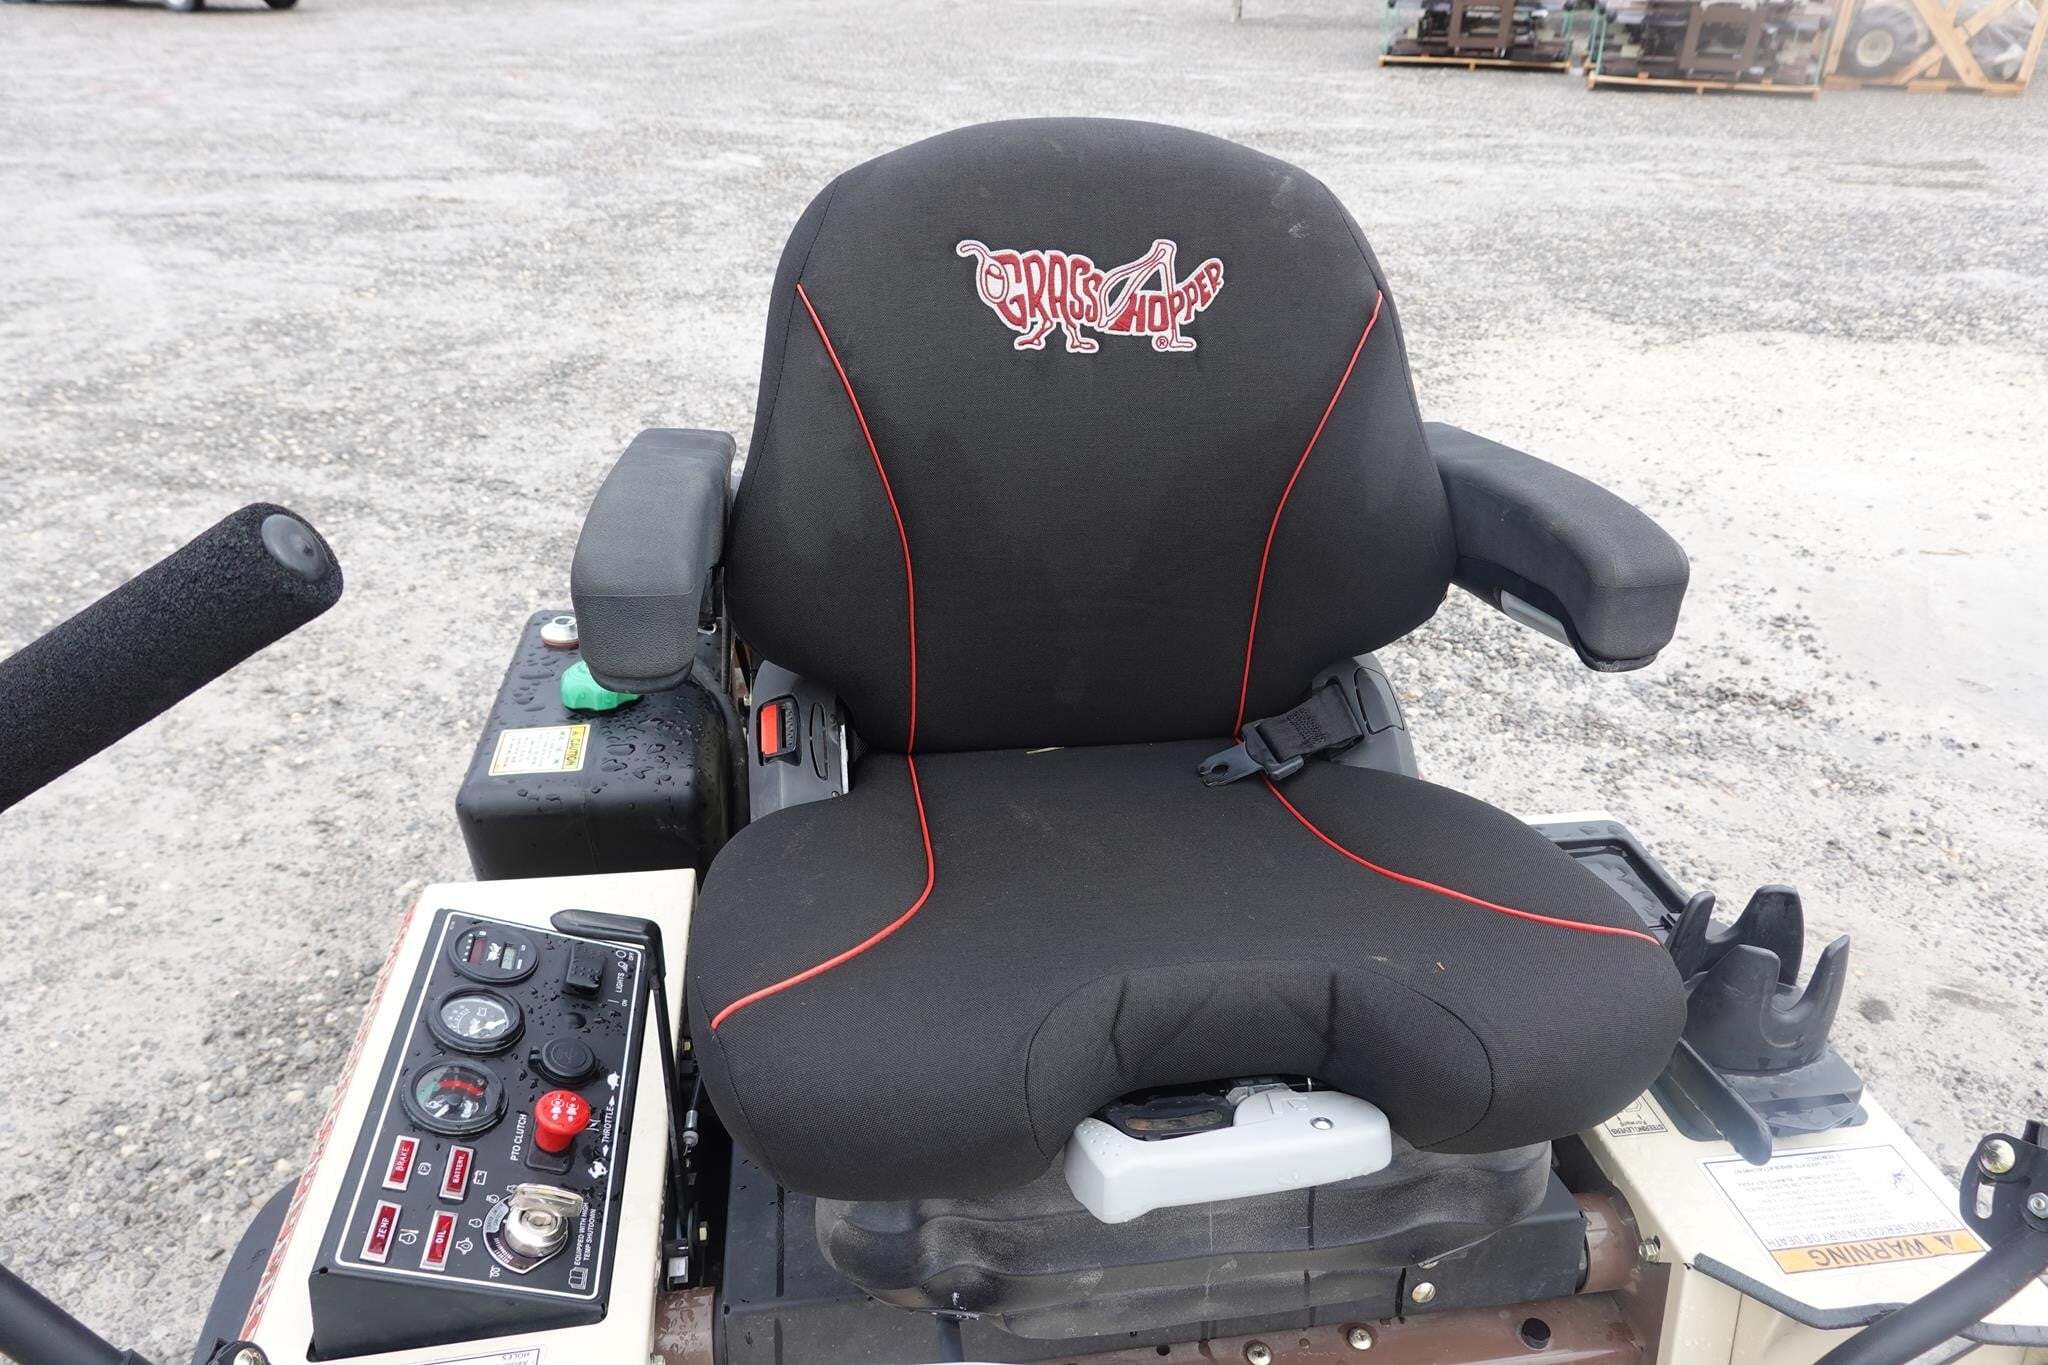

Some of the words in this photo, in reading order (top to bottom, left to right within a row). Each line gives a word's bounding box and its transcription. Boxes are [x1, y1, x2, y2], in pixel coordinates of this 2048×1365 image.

[565, 738, 580, 767] CAUTION
[616, 972, 625, 993] LIGHTS
[621, 999, 628, 1007] ON
[513, 1113, 528, 1144] CLUTCH
[601, 1105, 614, 1143] THROTTLE
[394, 1146, 410, 1172] BRAKE
[510, 1144, 522, 1161] PTO
[452, 1155, 465, 1184] BATTERY
[580, 1202, 589, 1217] HIGH
[376, 1216, 390, 1239] TEMP
[435, 1229, 447, 1244] OIL
[578, 1218, 587, 1234] WITH
[586, 1208, 596, 1243] SHUTDOWN
[574, 1234, 585, 1265] EQUIPPED
[583, 1243, 592, 1261] TEMP
[1766, 1234, 1802, 1247] DEATH
[1806, 1238, 1932, 1267] WARNING
